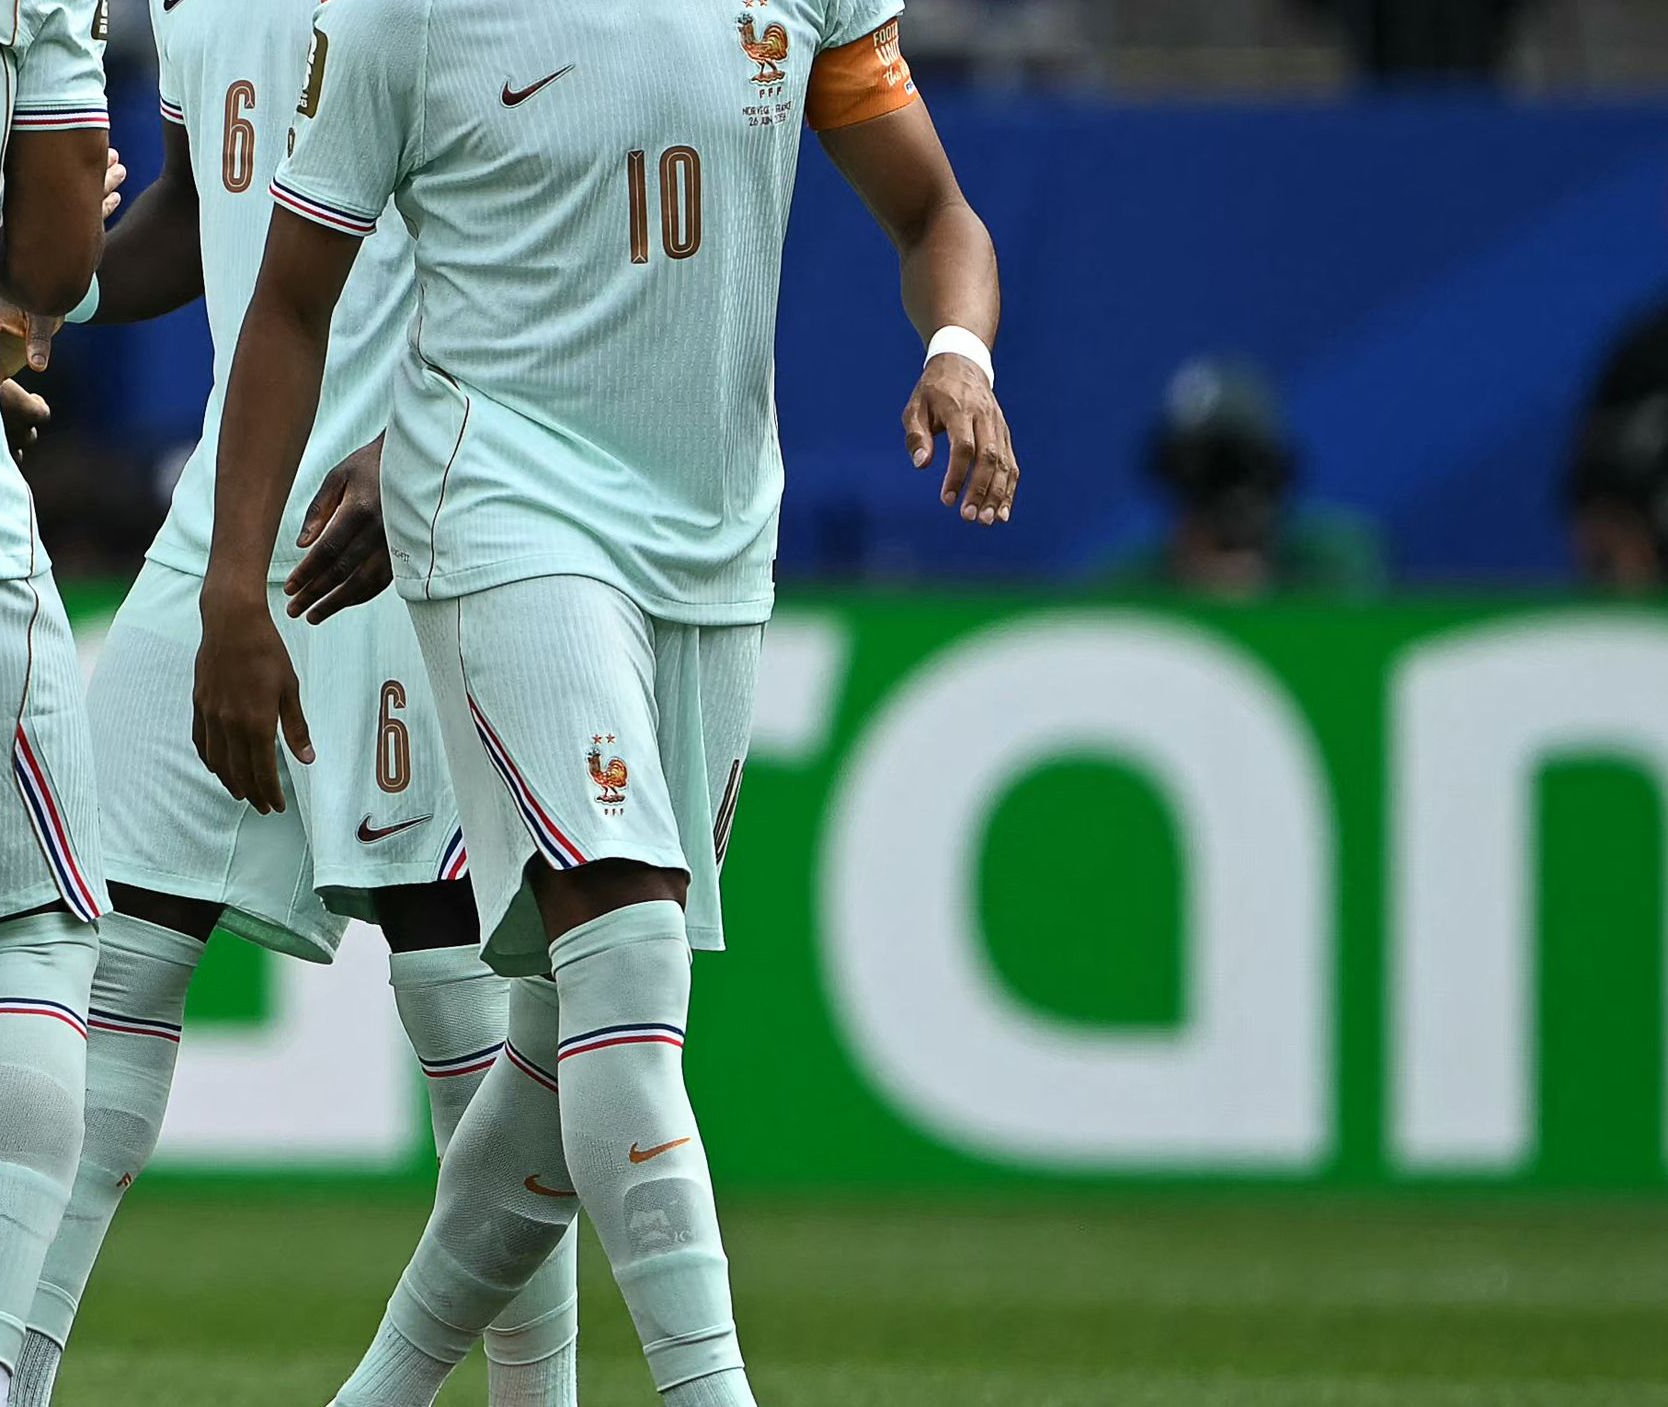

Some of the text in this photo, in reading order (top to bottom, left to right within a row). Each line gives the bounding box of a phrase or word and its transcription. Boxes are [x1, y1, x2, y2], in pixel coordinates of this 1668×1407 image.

[222, 80, 255, 193] 6
[627, 145, 701, 264] 10
[376, 679, 411, 793] 6
